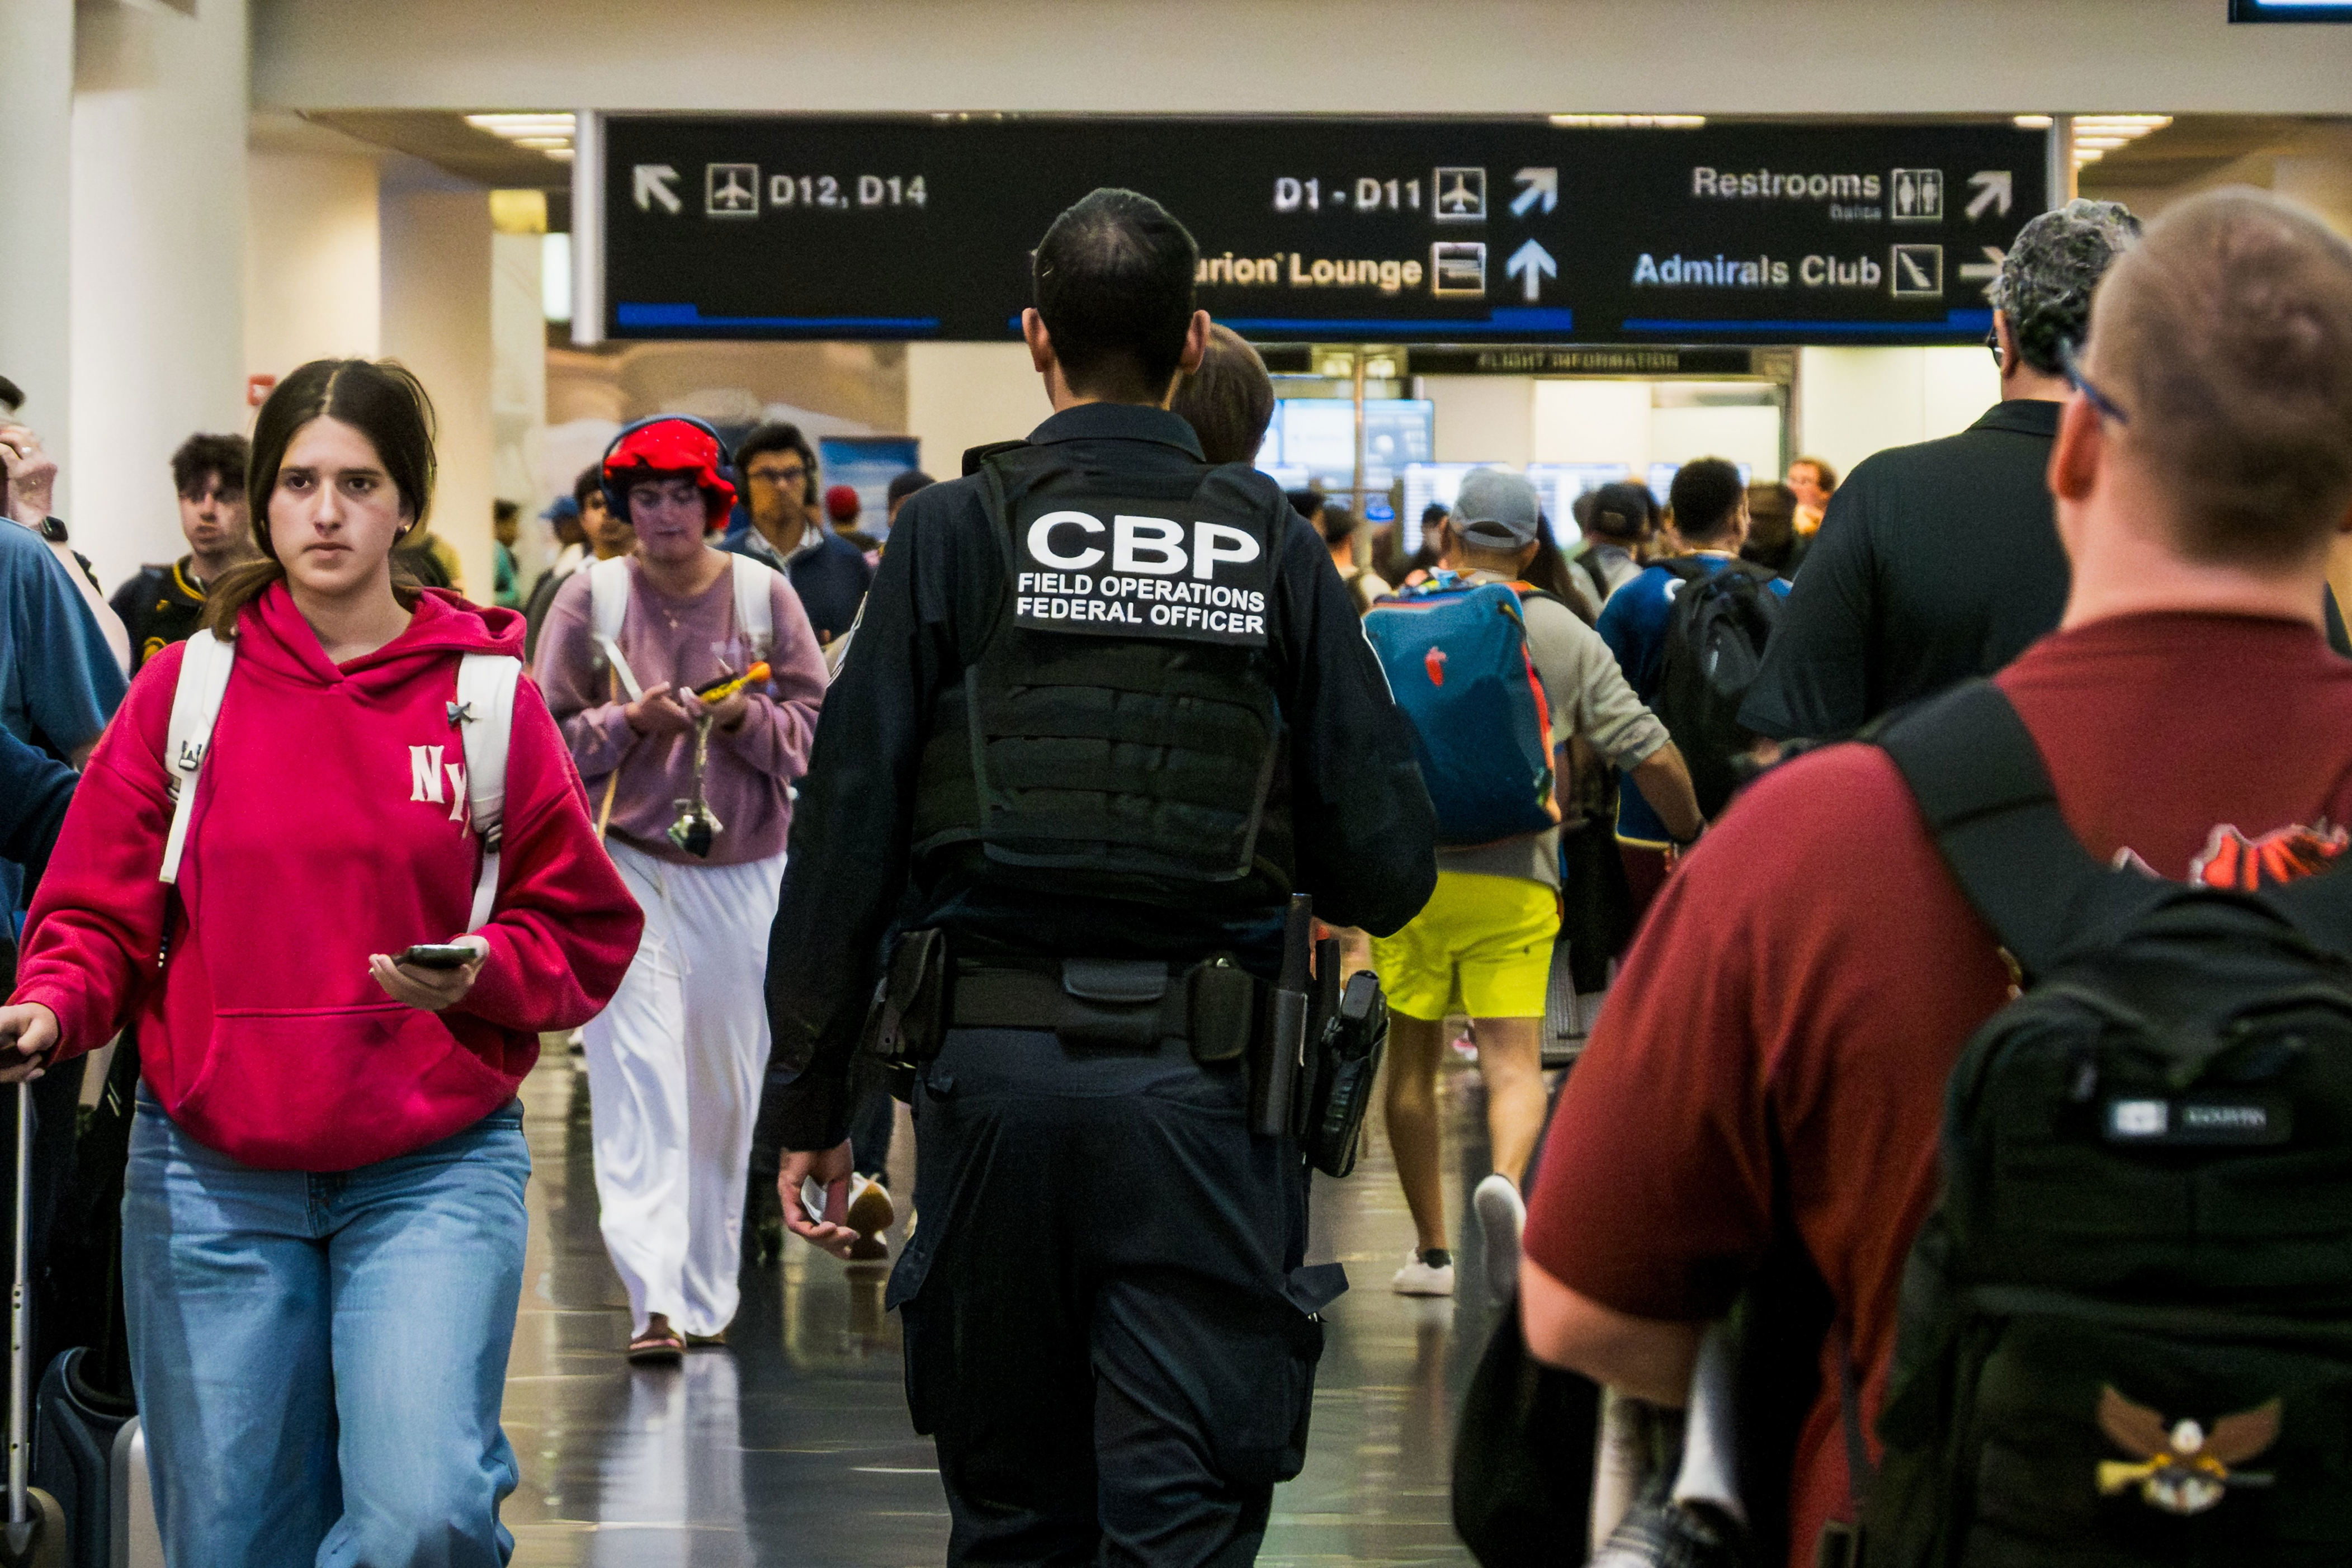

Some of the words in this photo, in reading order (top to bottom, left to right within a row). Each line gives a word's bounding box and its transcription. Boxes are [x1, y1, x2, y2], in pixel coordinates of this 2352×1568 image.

[770, 175, 848, 209] D12,
[859, 175, 926, 205] D14
[1274, 177, 1319, 209] D1
[1356, 178, 1420, 207] D11
[1693, 167, 1881, 197] Restrooms
[1290, 253, 1422, 293] Lounge
[1634, 254, 1789, 285] Admirals
[1800, 254, 1881, 285] Club
[1027, 511, 1260, 580] CBP
[1018, 572, 1093, 594] FIELD
[1100, 575, 1265, 612] OPERATIONS
[1017, 597, 1142, 624] FEDERAL
[1150, 604, 1265, 634] OFFICER
